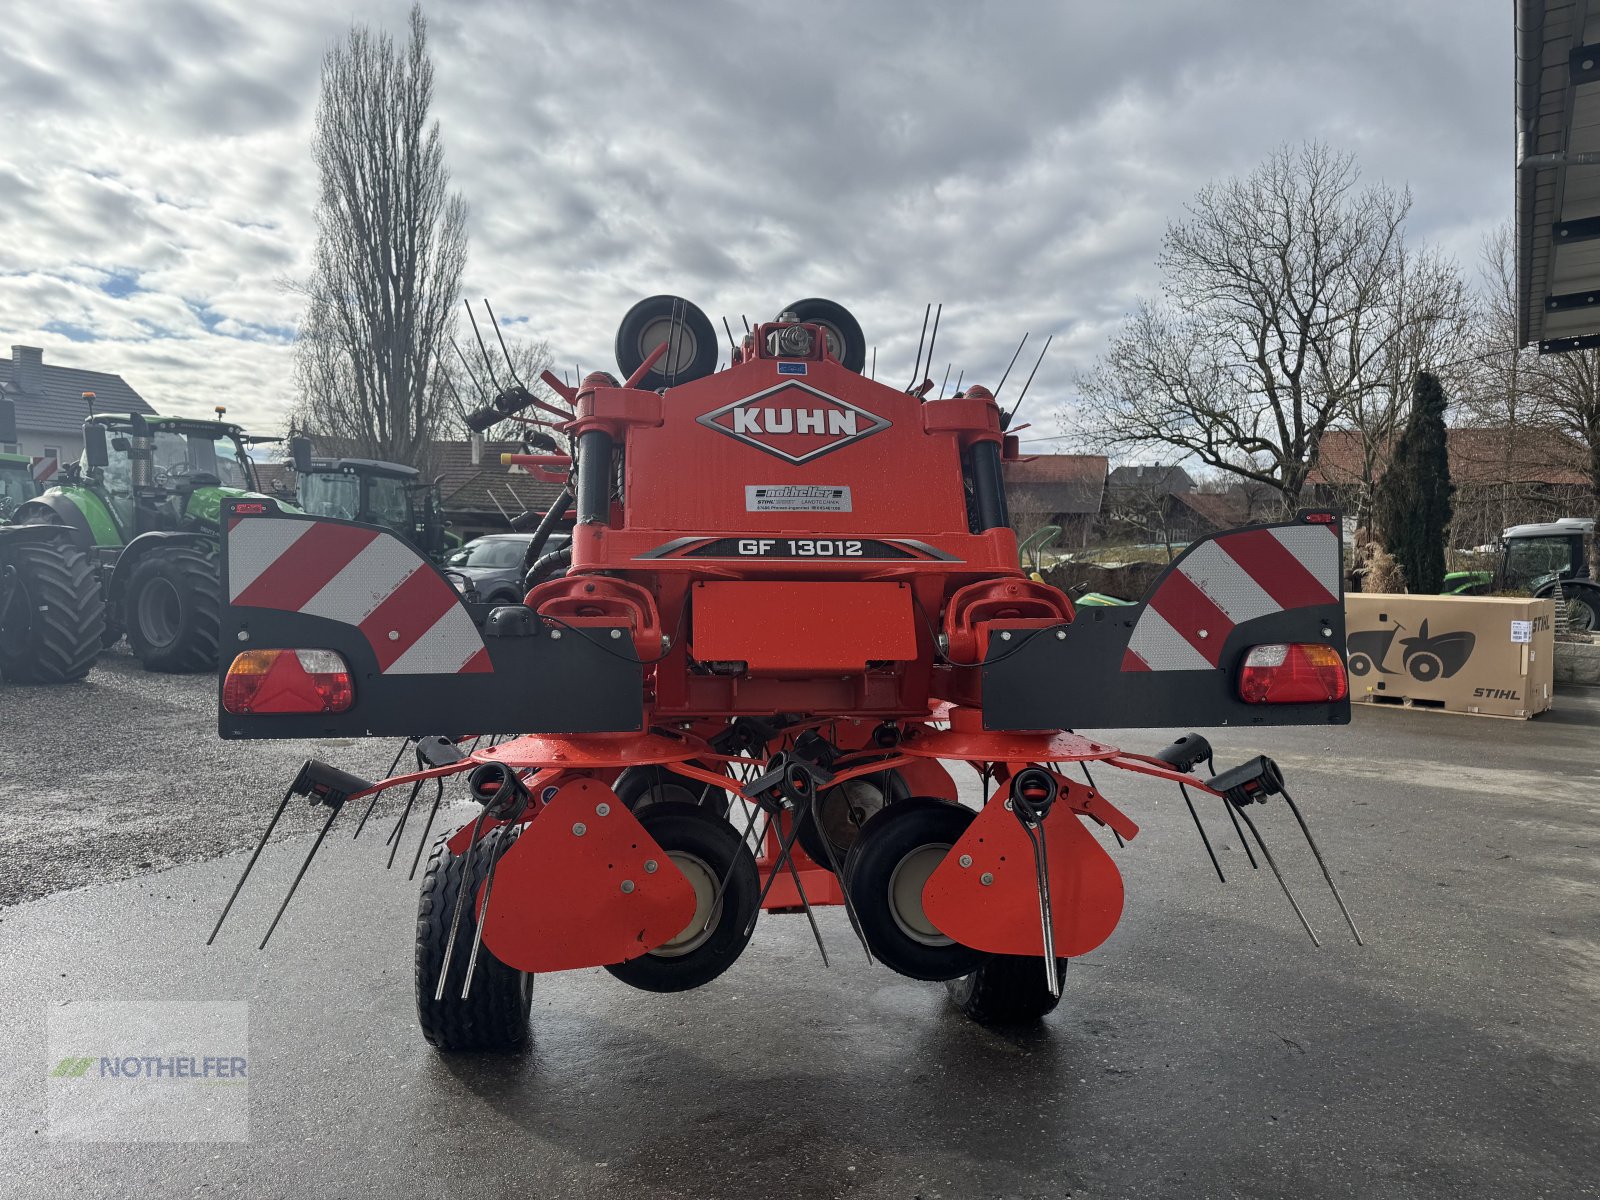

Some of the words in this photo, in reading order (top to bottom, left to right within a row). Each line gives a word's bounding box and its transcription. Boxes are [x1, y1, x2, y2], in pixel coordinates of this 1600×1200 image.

[733, 407, 857, 436] KUHN
[738, 539, 776, 555] GF
[787, 540, 863, 556] 13012
[1473, 687, 1520, 701] STIHL
